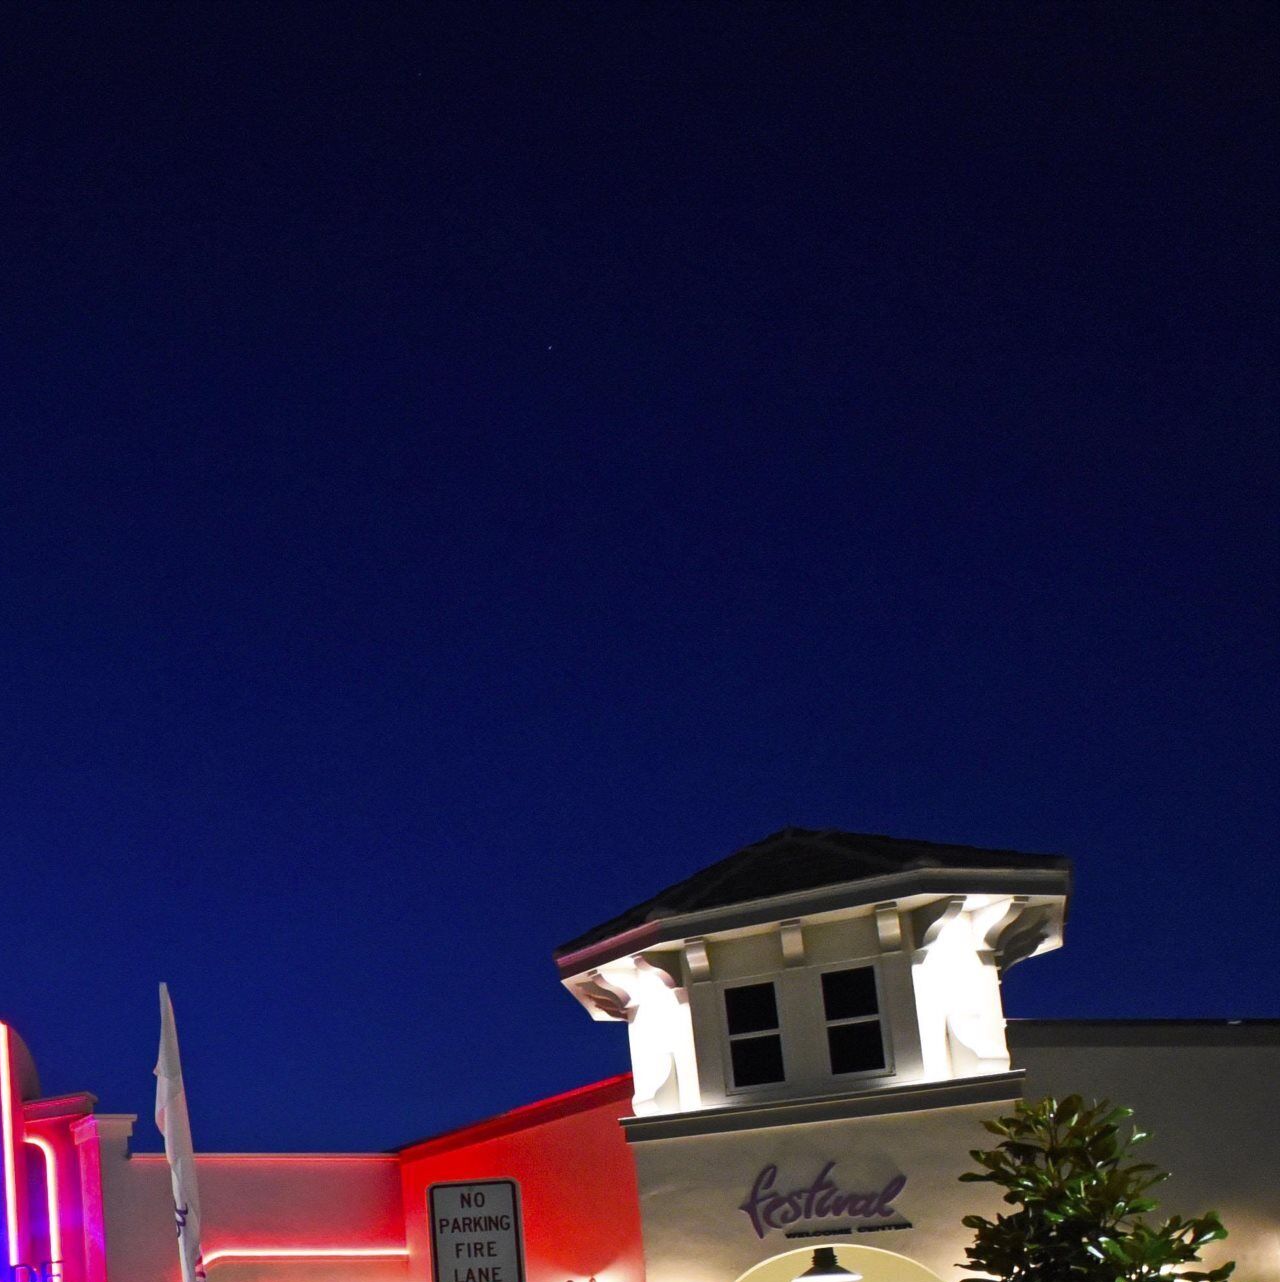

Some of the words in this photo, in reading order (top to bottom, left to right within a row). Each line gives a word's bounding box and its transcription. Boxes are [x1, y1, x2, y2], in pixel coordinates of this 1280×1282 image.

[460, 1192, 485, 1209] NO
[438, 1215, 511, 1234] PARKING
[785, 1227, 852, 1239] WELCOME
[857, 1222, 913, 1234] CENTER
[455, 1242, 497, 1259] FIRE
